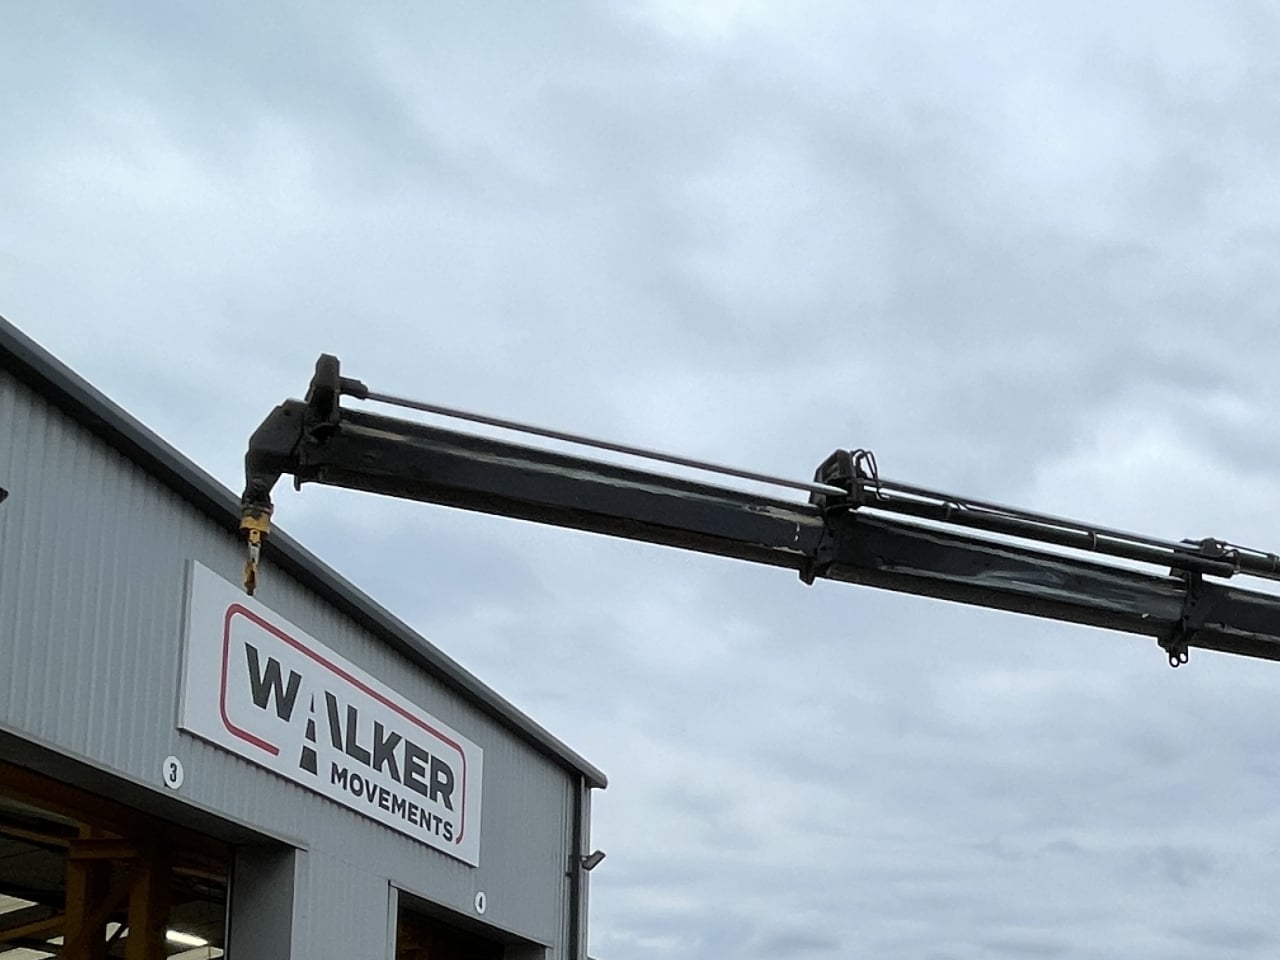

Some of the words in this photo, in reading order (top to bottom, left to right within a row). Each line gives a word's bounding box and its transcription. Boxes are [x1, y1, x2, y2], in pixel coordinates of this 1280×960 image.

[245, 641, 455, 812] WALKER
[169, 762, 178, 783] 3
[330, 761, 454, 843] MOVEMENTS
